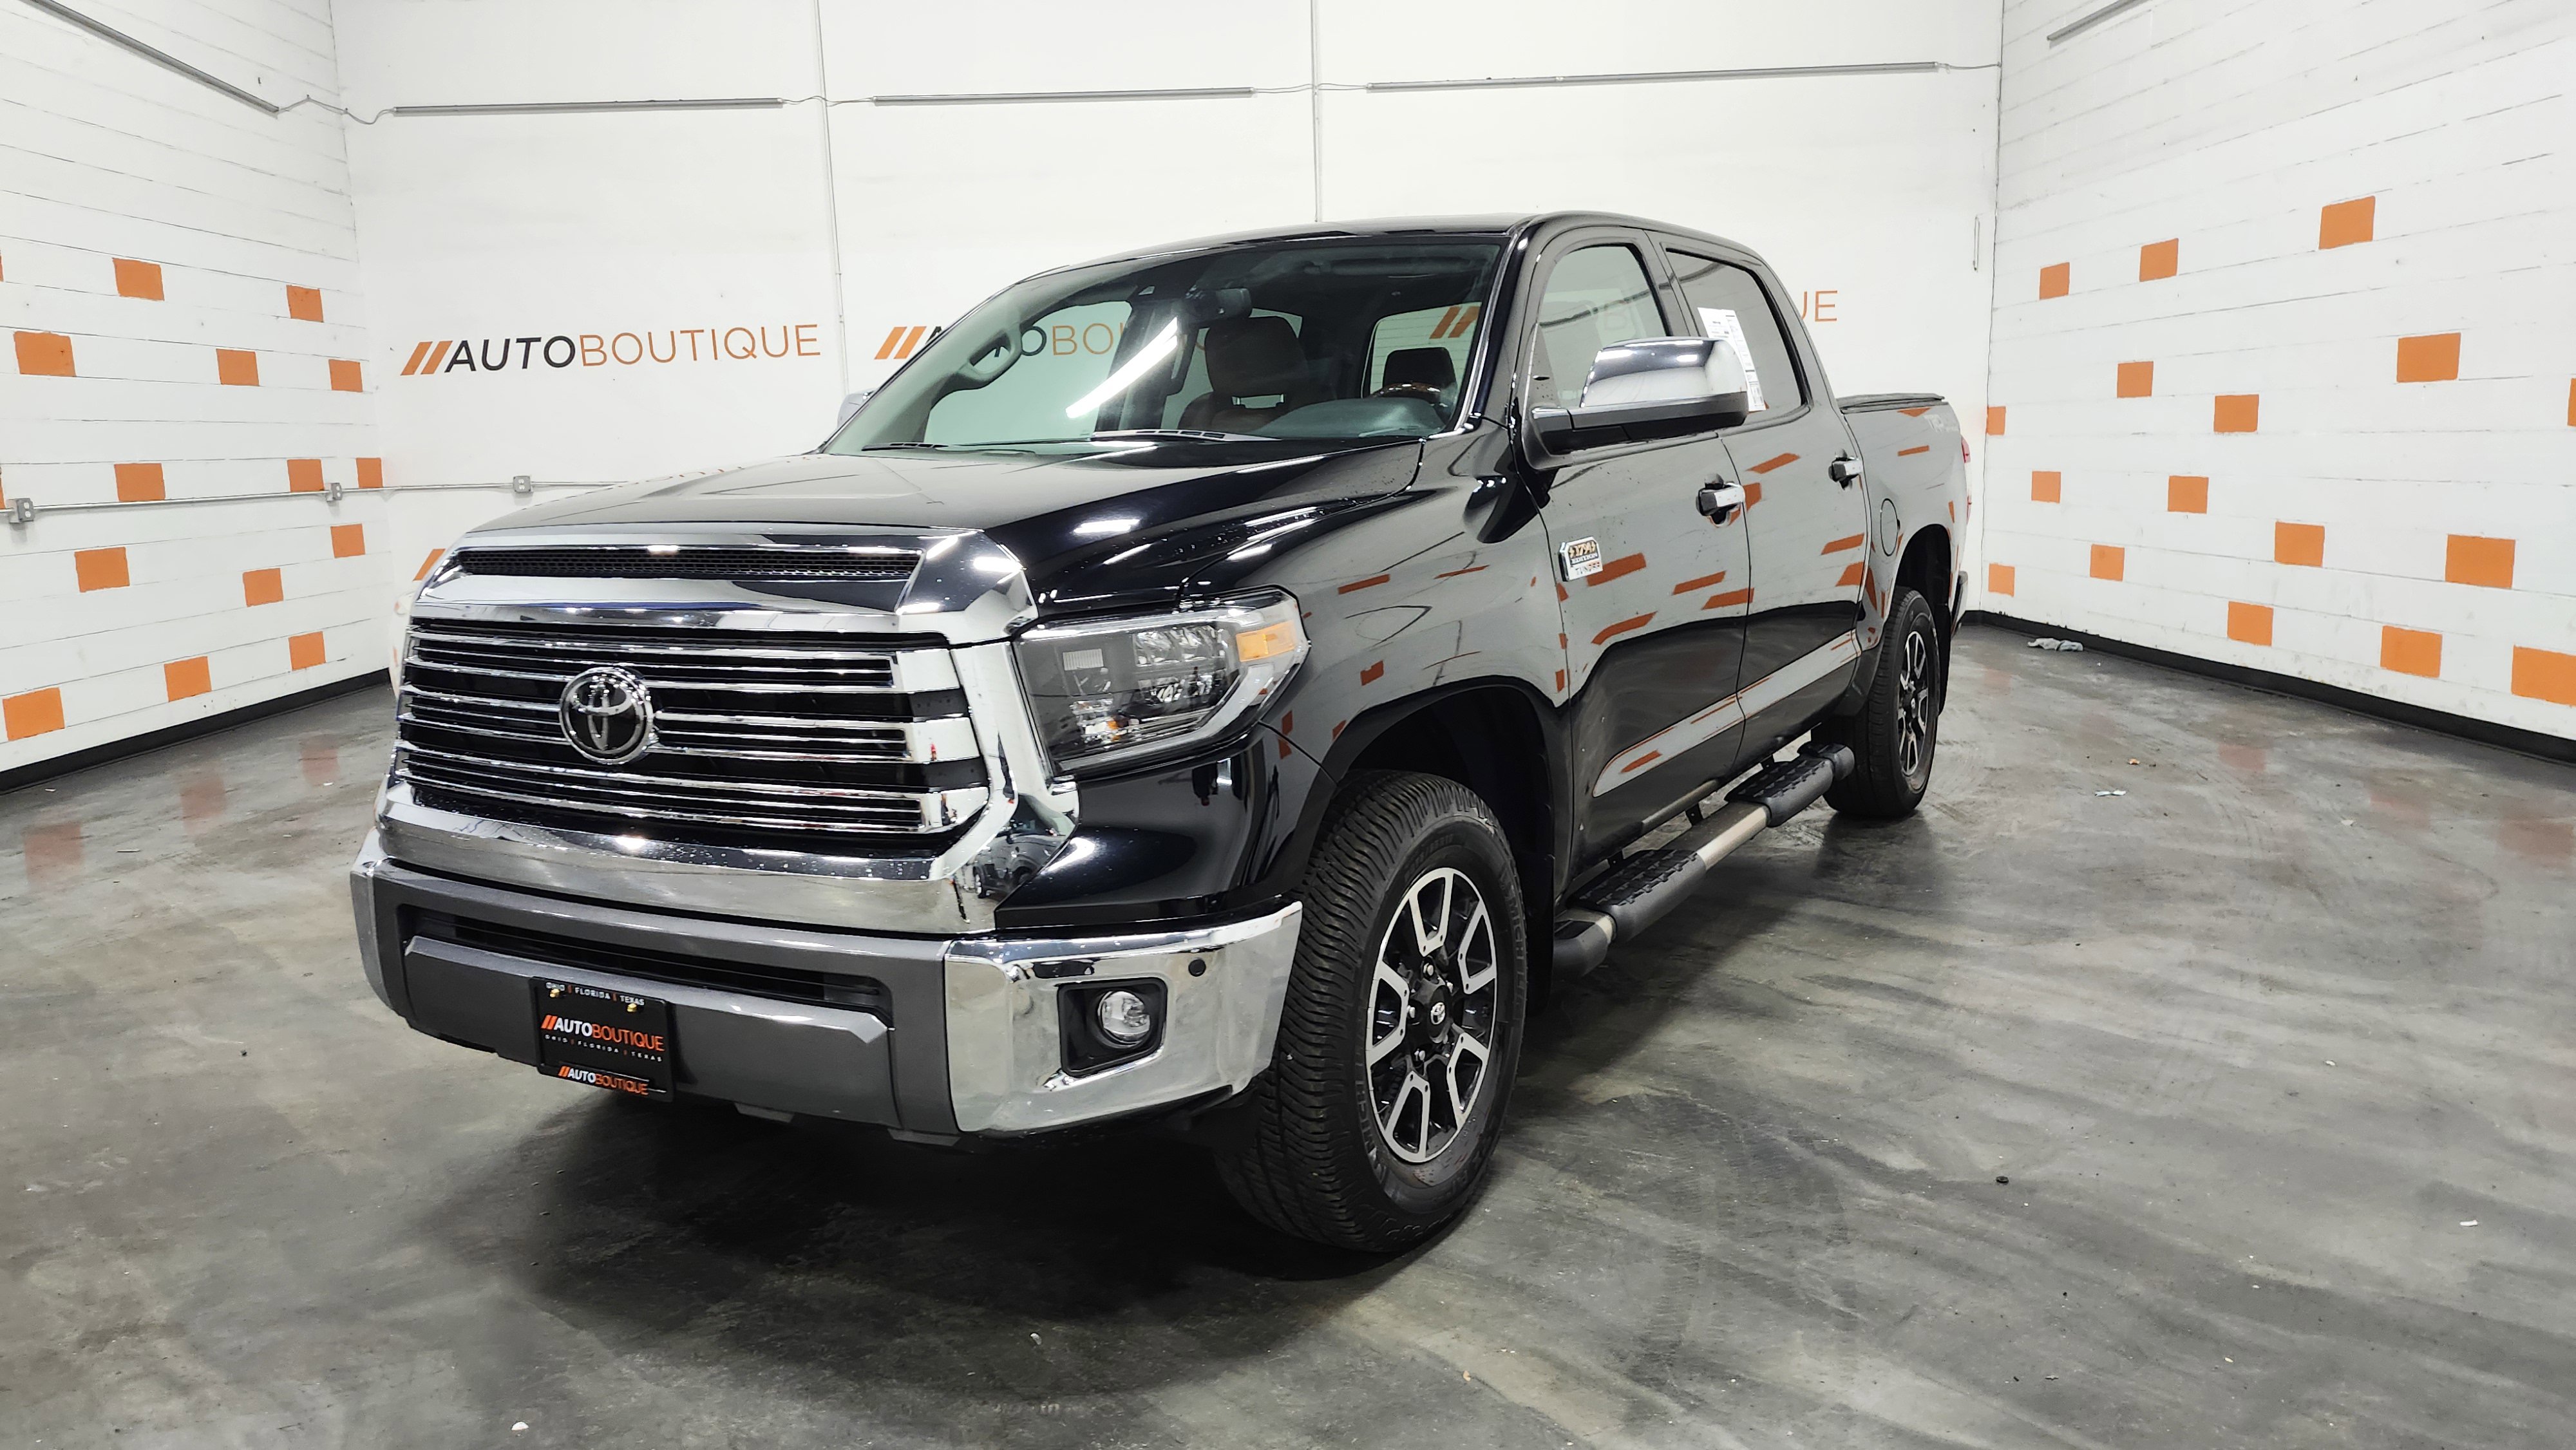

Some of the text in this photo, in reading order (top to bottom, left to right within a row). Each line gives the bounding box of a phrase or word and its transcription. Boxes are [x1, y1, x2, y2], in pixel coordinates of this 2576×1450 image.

[574, 987, 611, 1000] FLORIDA
[620, 995, 645, 1006] TEXAS
[577, 1040, 619, 1053] FLORIDA
[630, 1051, 663, 1062] TEXAS
